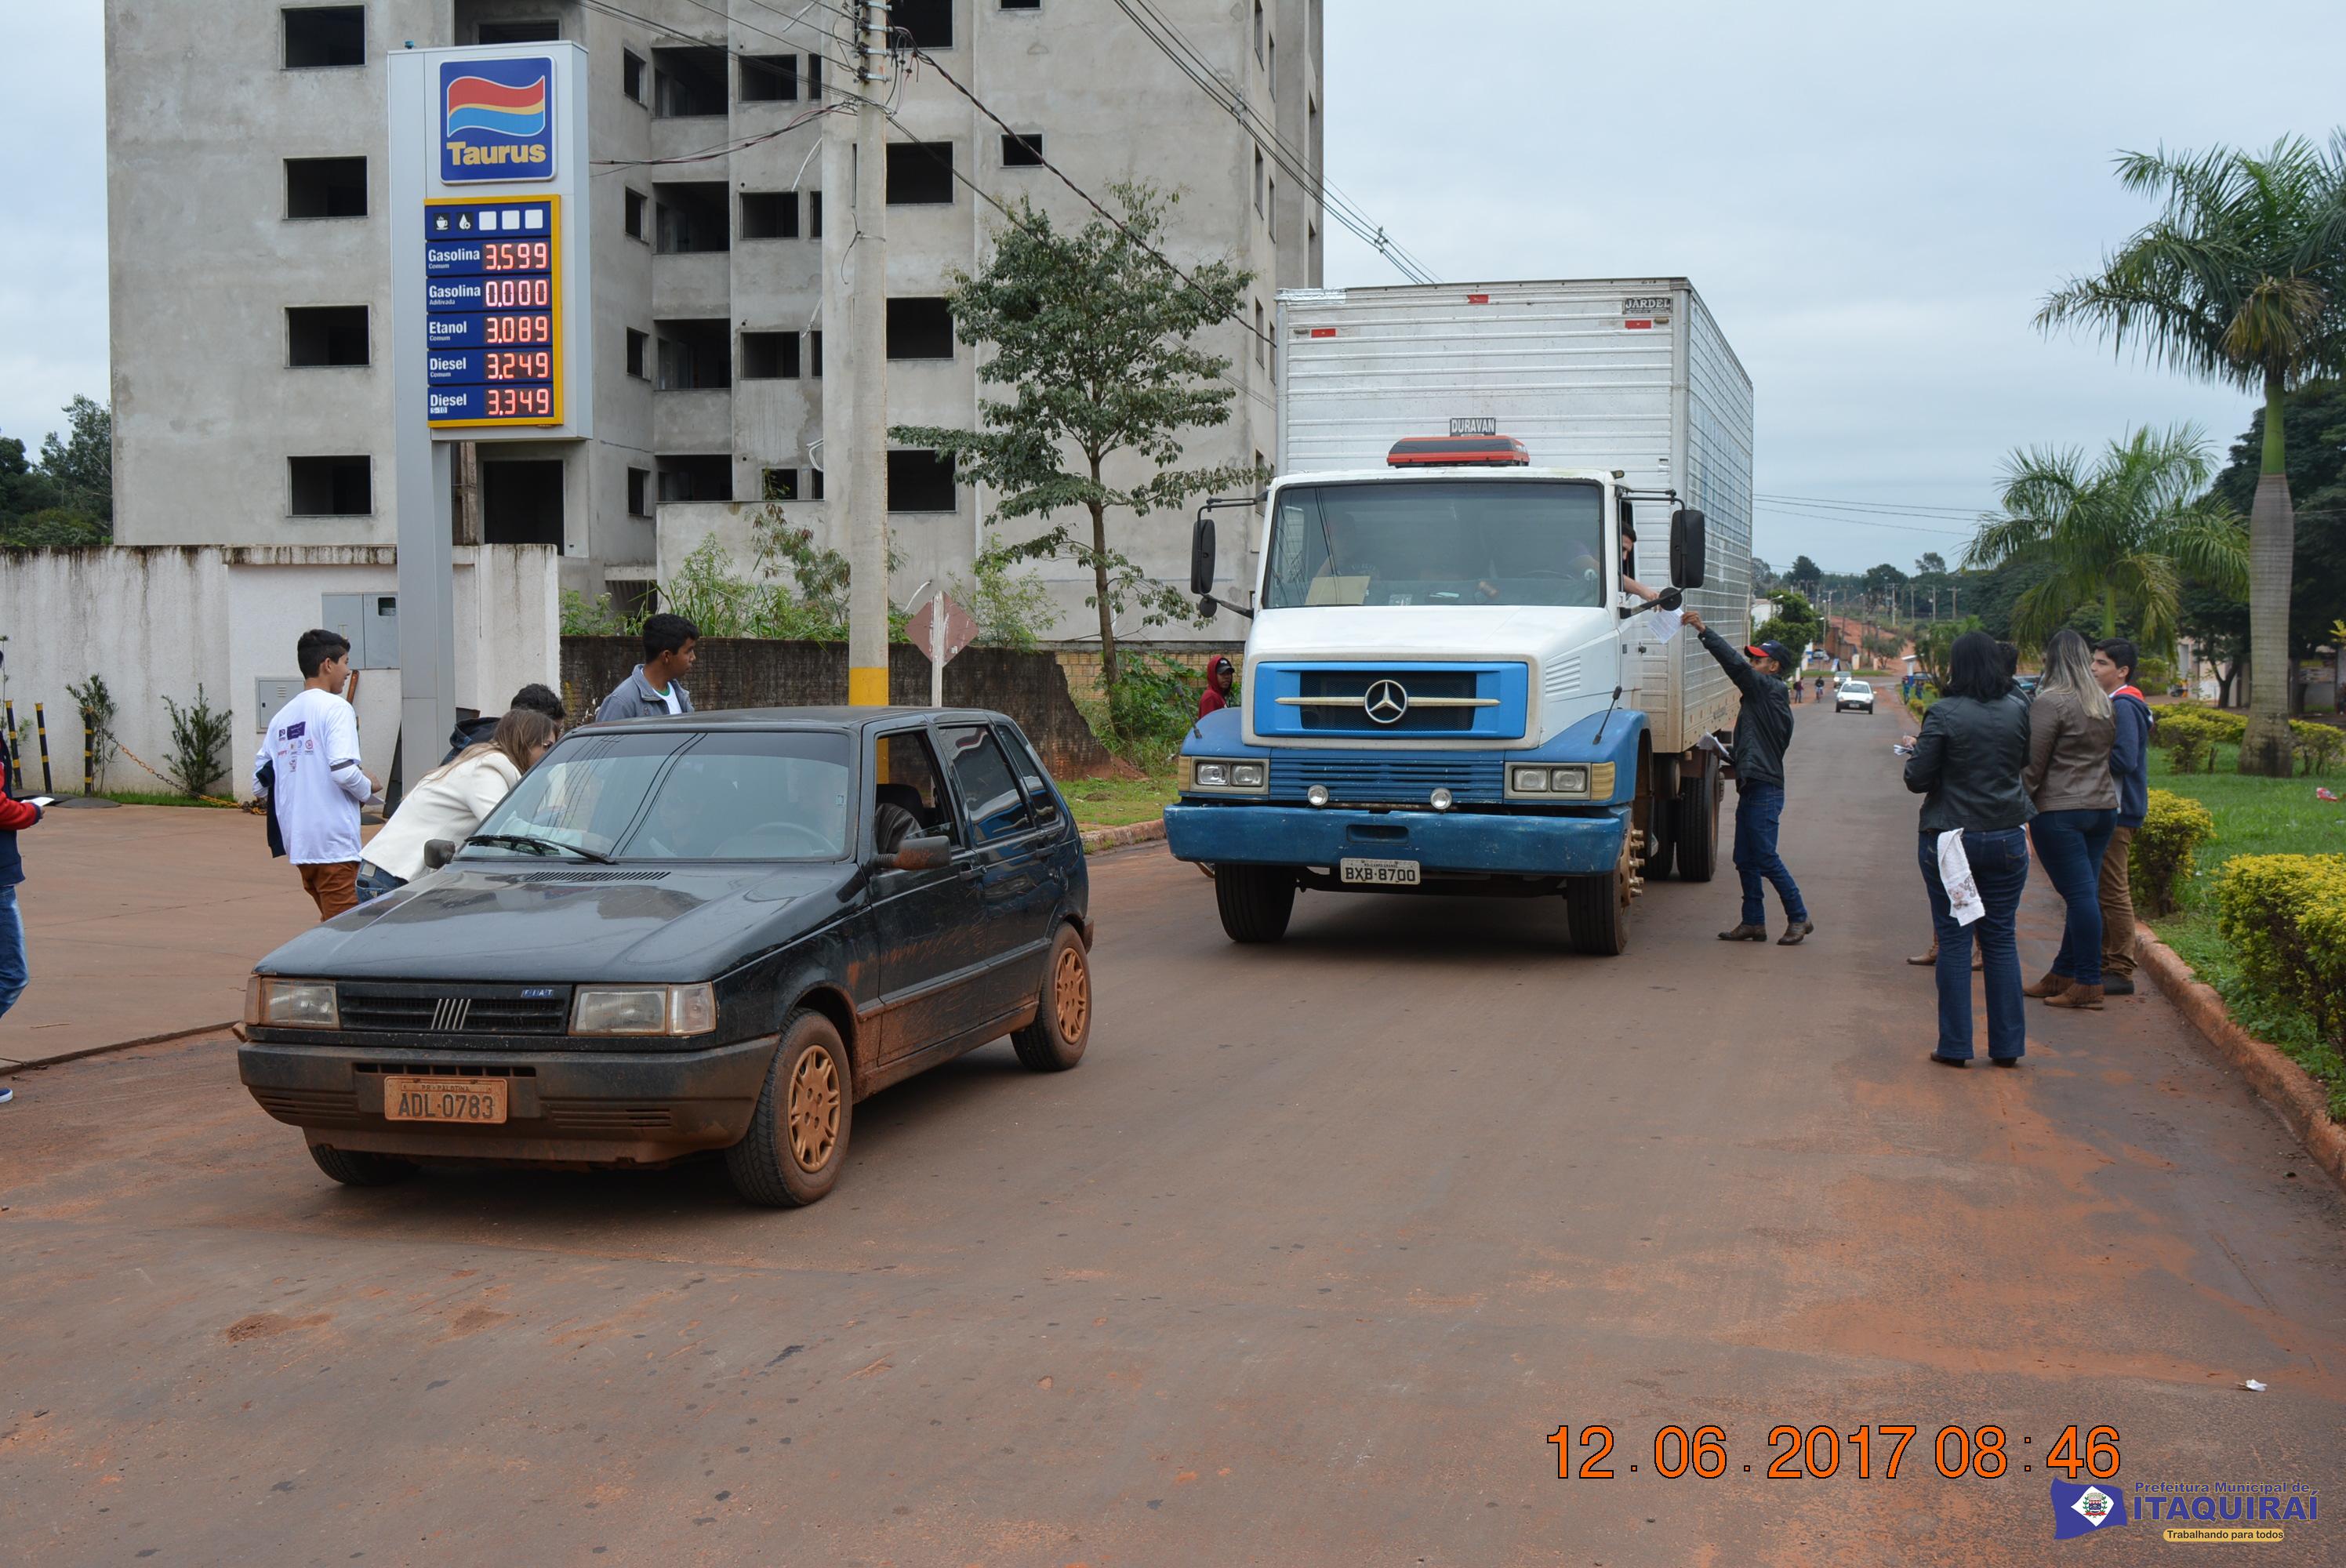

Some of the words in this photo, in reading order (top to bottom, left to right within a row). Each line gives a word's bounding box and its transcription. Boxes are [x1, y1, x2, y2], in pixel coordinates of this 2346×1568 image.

[446, 141, 547, 165] Taurus
[428, 249, 480, 262] Gasolina
[485, 242, 547, 270] 3.599
[429, 285, 481, 298] Gasolina
[485, 280, 547, 307] 0.000
[1625, 299, 1670, 308] JARDEL
[429, 321, 467, 334] Etanol
[487, 316, 548, 343] 3.089
[430, 358, 467, 370] Diesel
[487, 352, 549, 379] 3.249
[430, 394, 467, 406] Diesel
[488, 388, 549, 416] 3.349
[1451, 419, 1494, 433] DURAVAN
